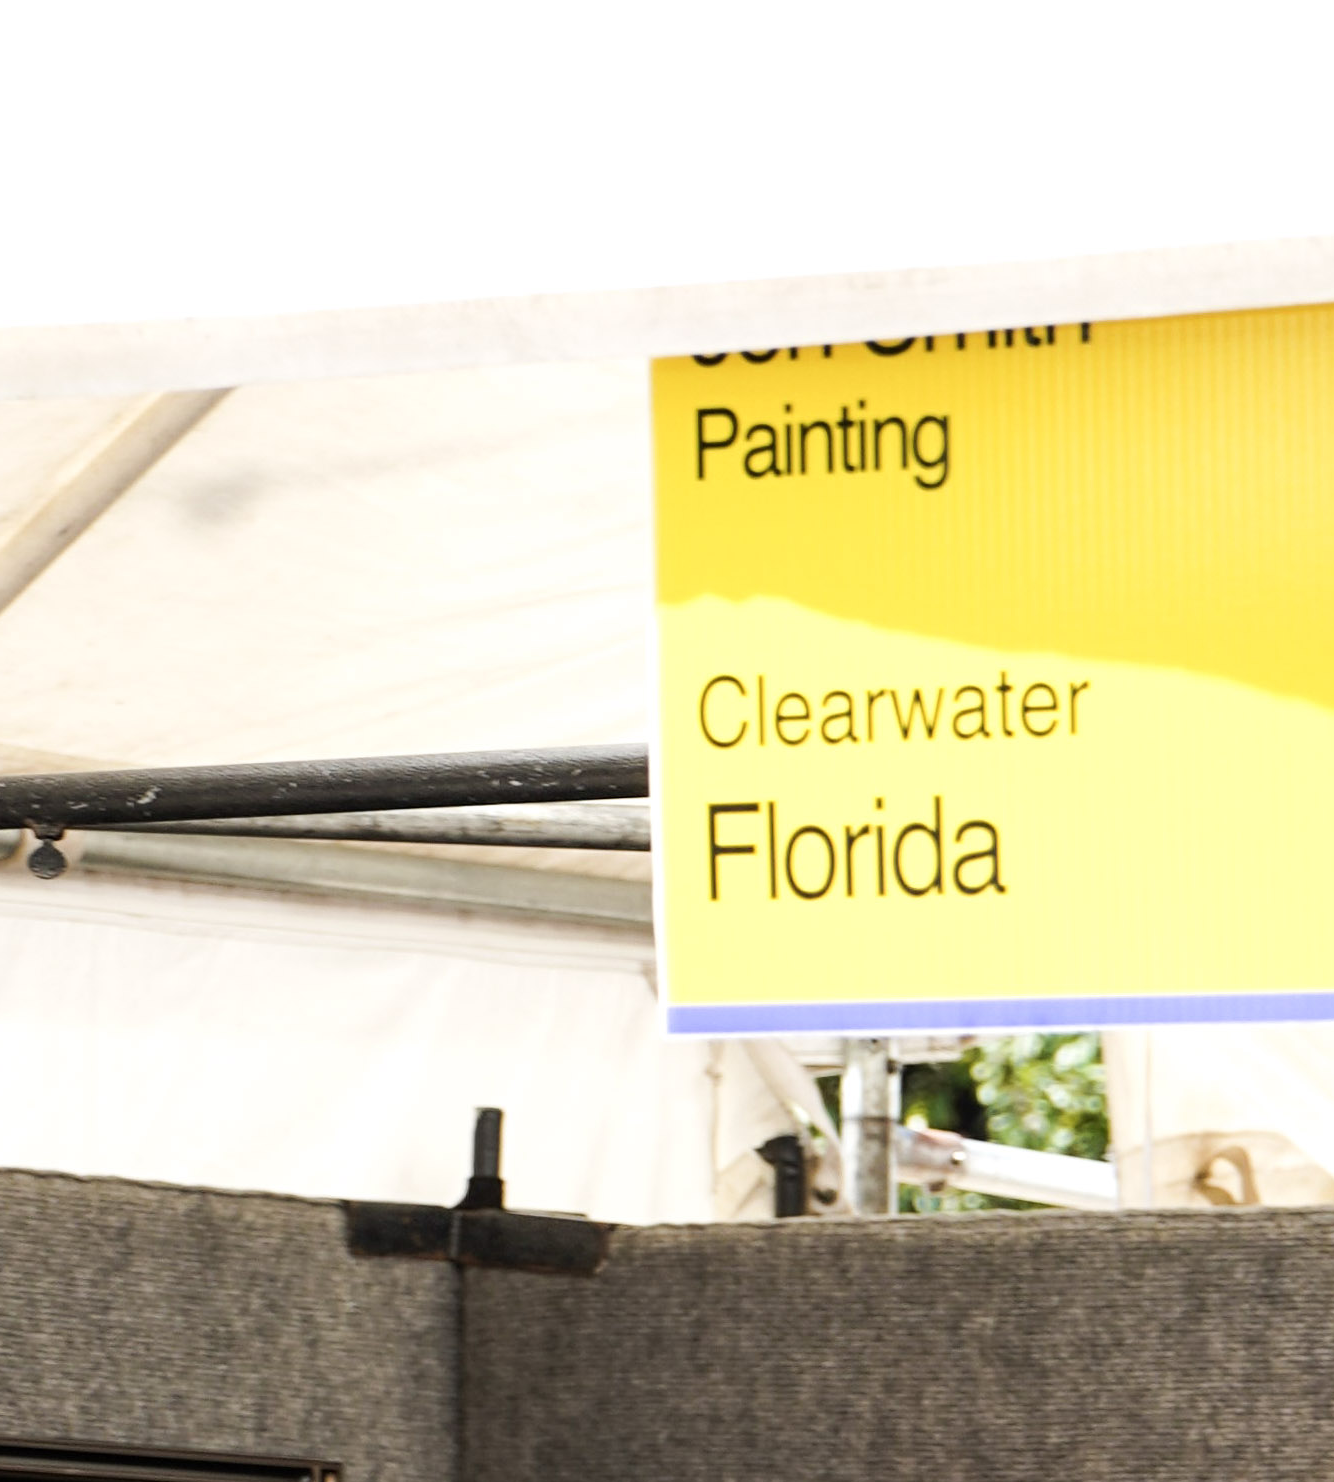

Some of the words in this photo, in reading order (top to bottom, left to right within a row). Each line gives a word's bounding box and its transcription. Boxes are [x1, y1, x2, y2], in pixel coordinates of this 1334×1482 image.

[696, 399, 951, 490] Painting
[699, 671, 1090, 748] Clearwater
[707, 795, 1008, 900] Florida
